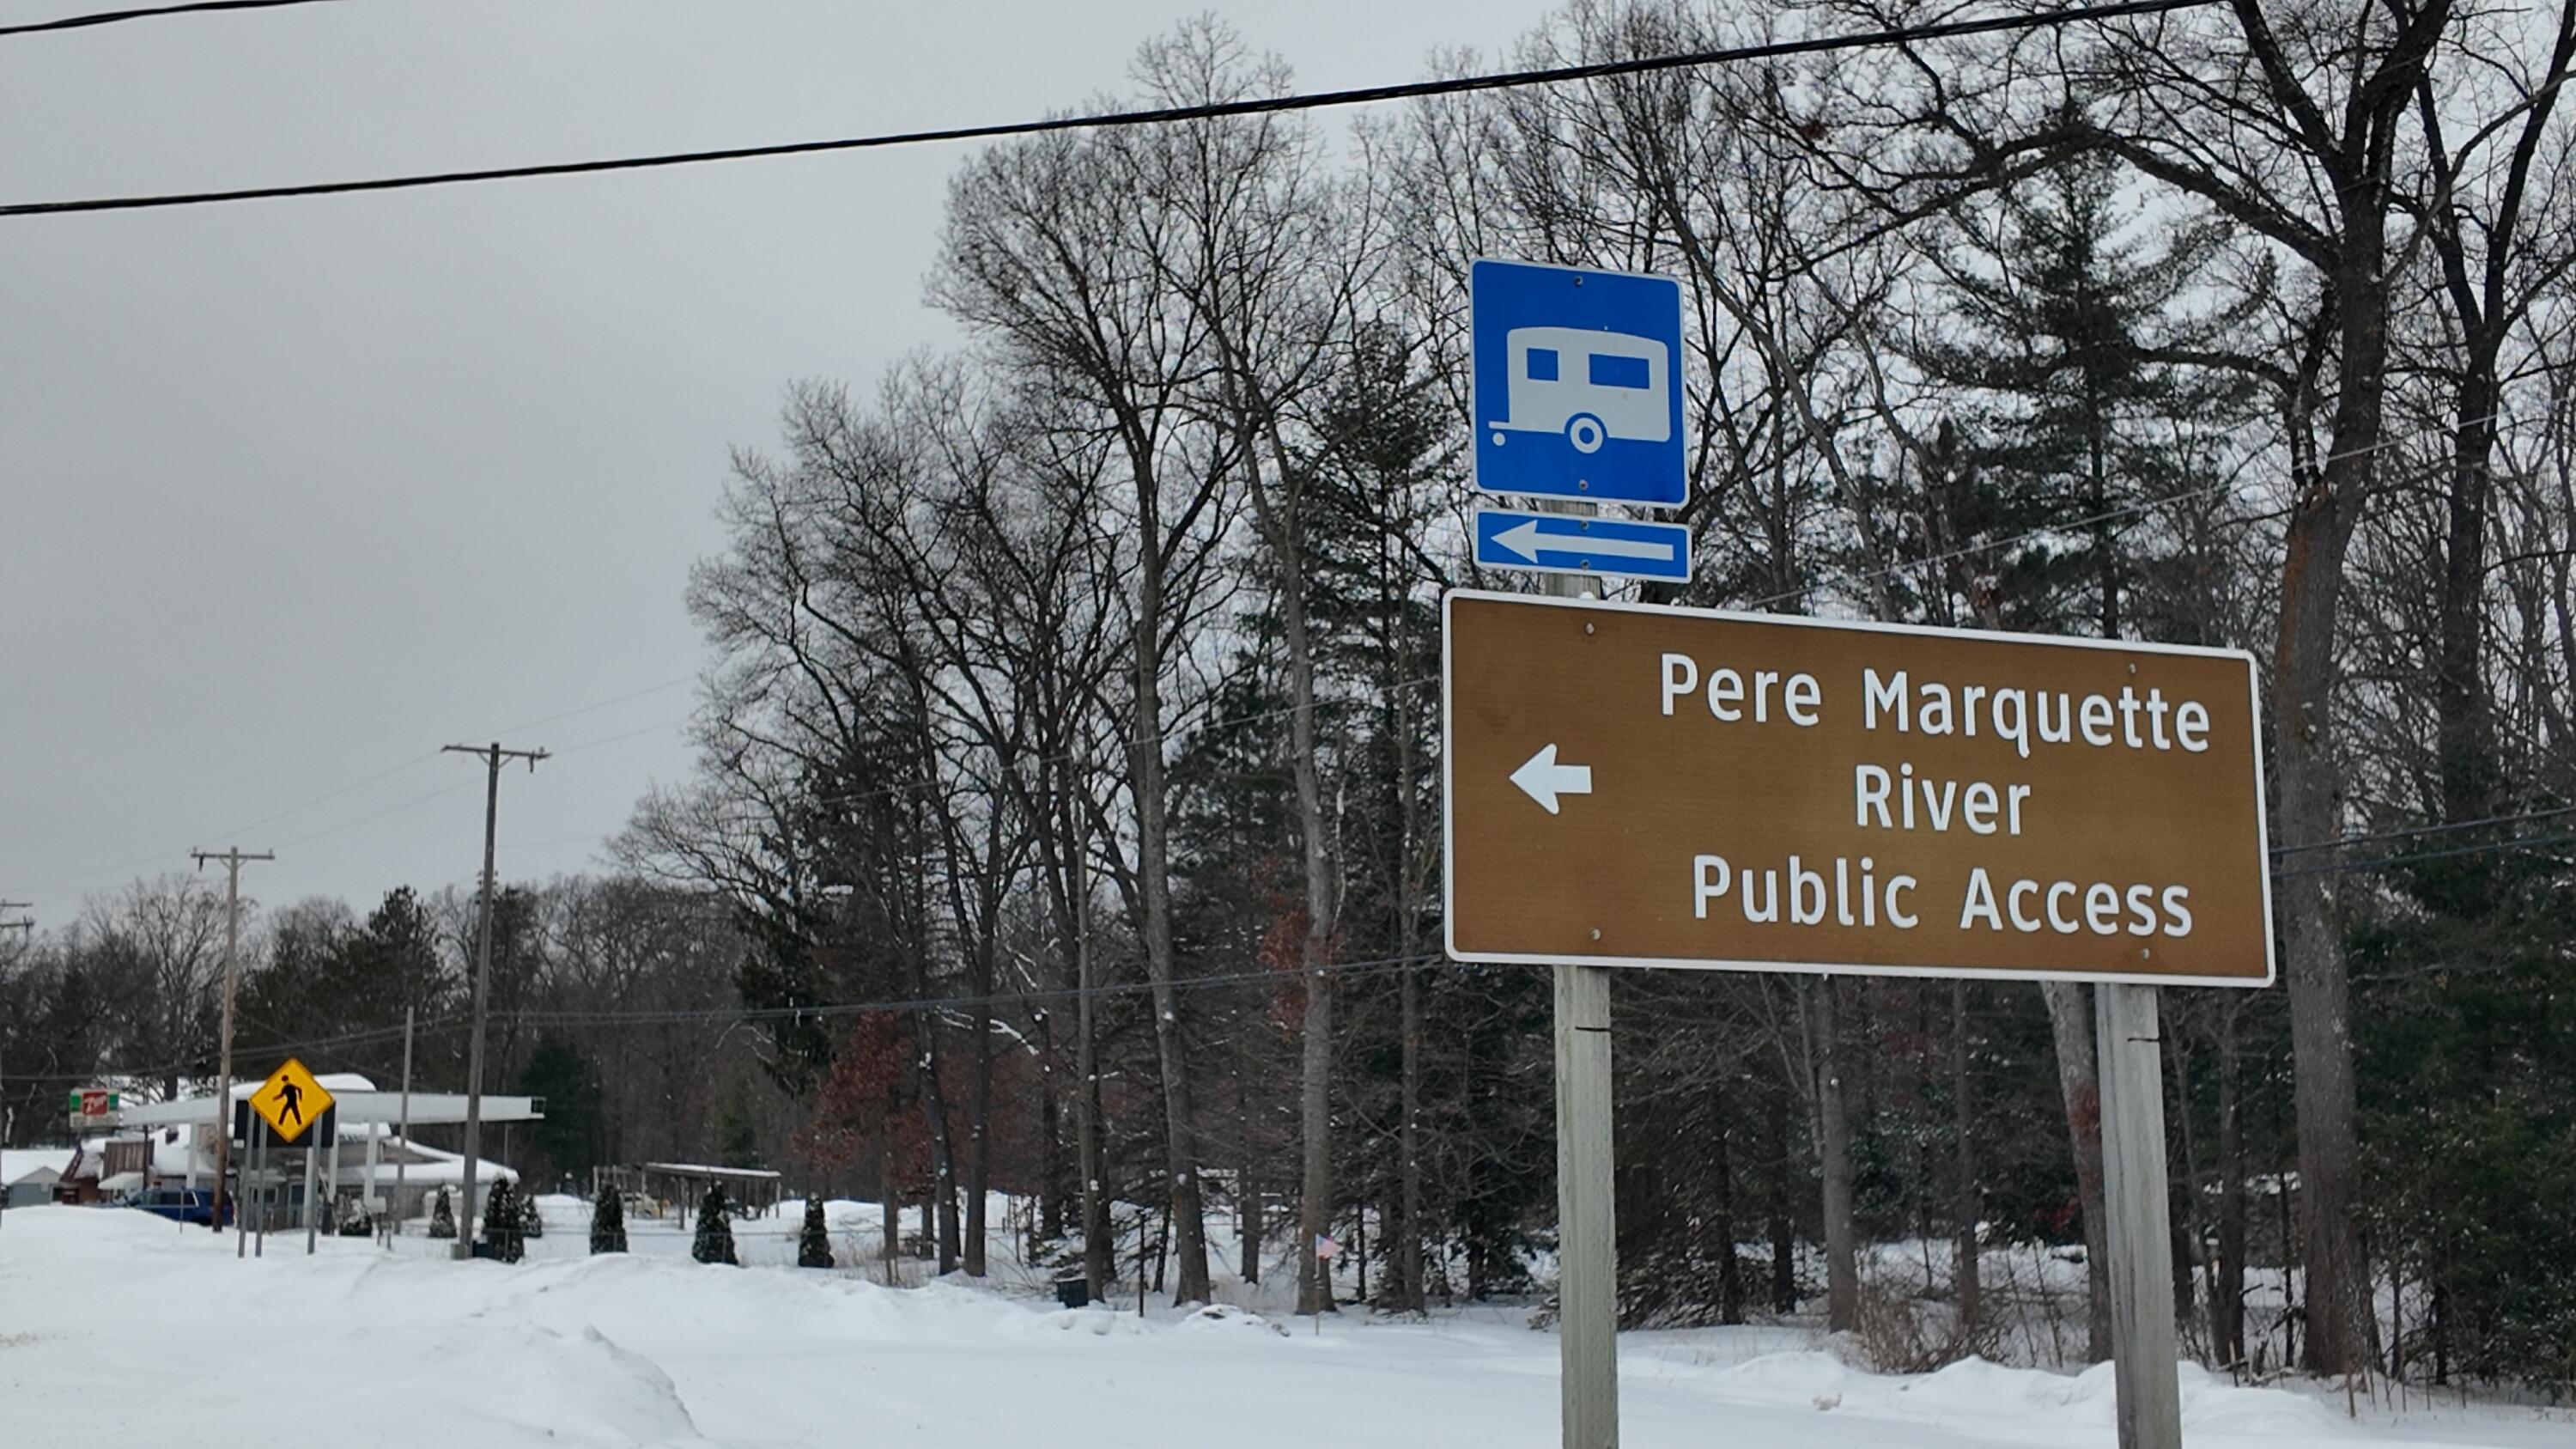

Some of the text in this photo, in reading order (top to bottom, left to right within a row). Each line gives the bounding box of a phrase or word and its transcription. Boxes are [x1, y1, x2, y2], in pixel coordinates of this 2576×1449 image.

[1661, 652, 2210, 759] Pere Marquette
[1855, 761, 2032, 836] River
[1692, 854, 2193, 938] Public Access
